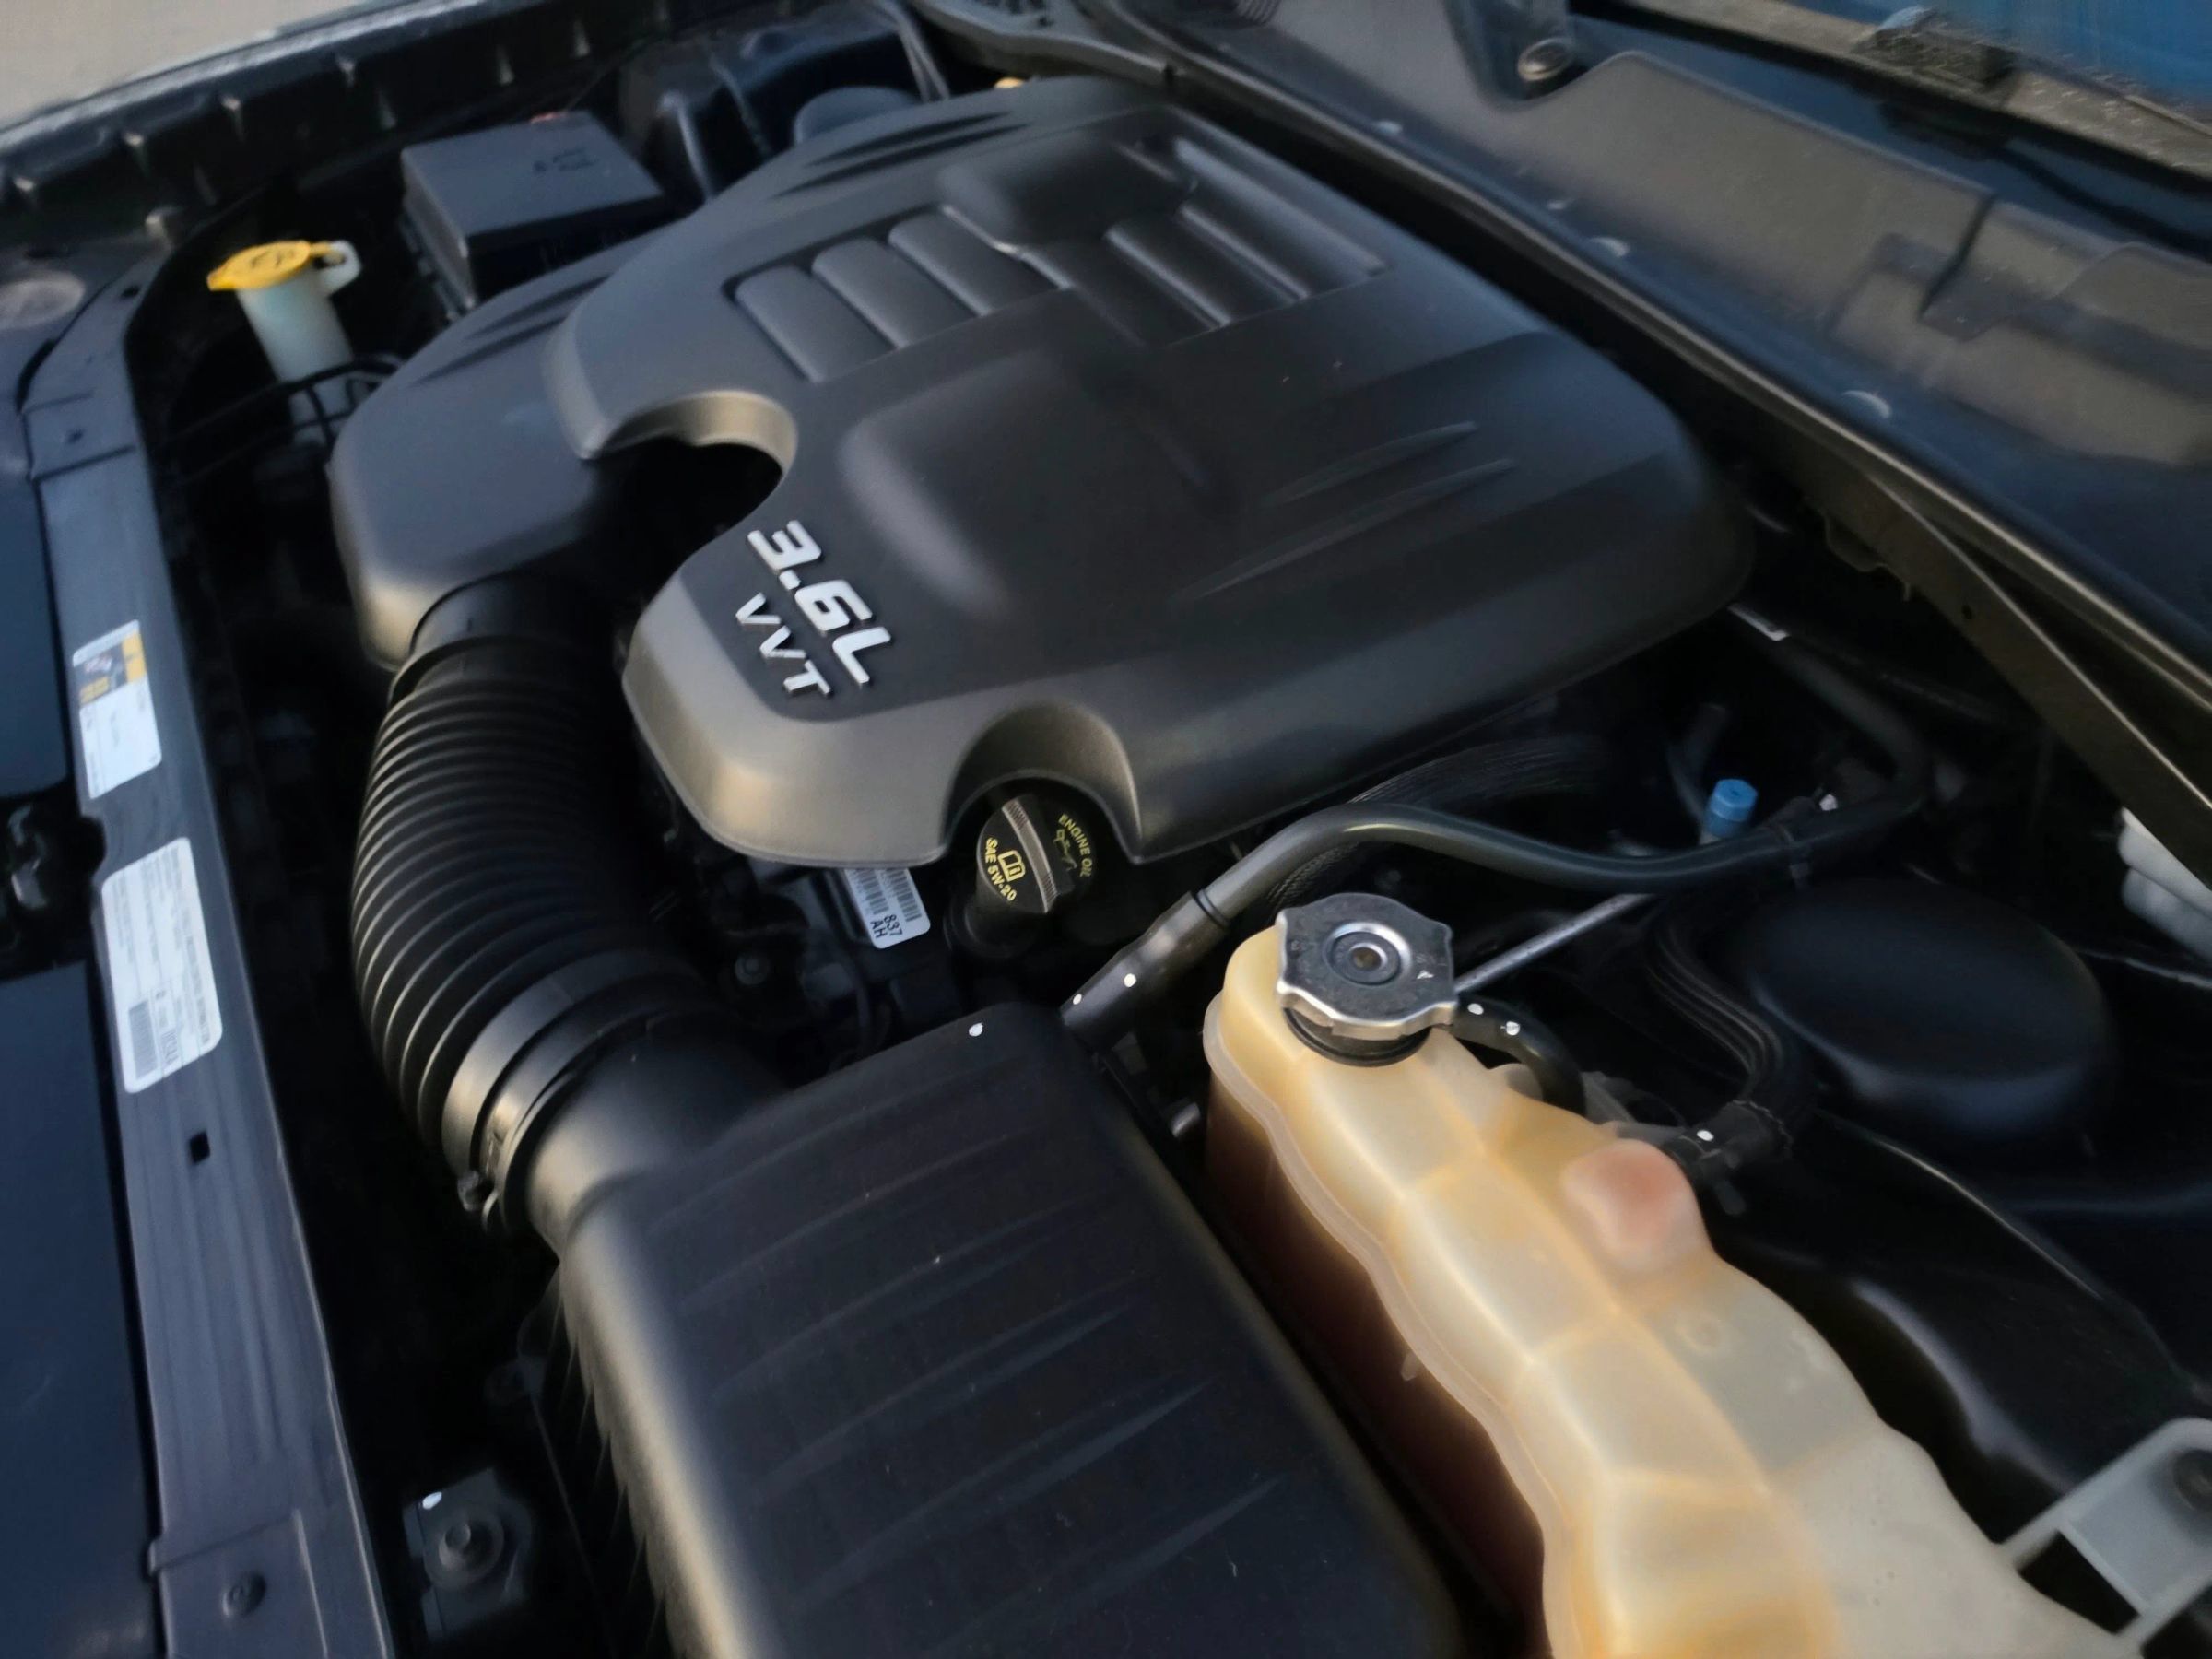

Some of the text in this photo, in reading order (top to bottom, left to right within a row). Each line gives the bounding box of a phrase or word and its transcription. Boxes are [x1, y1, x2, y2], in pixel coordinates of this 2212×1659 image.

[747, 519, 891, 685] 3.6L
[735, 592, 831, 694] VVT
[984, 837, 1018, 901] SAE 5W-20
[1058, 813, 1093, 877] ENGINE OIL
[870, 920, 888, 939] AH
[884, 913, 903, 936] 837
